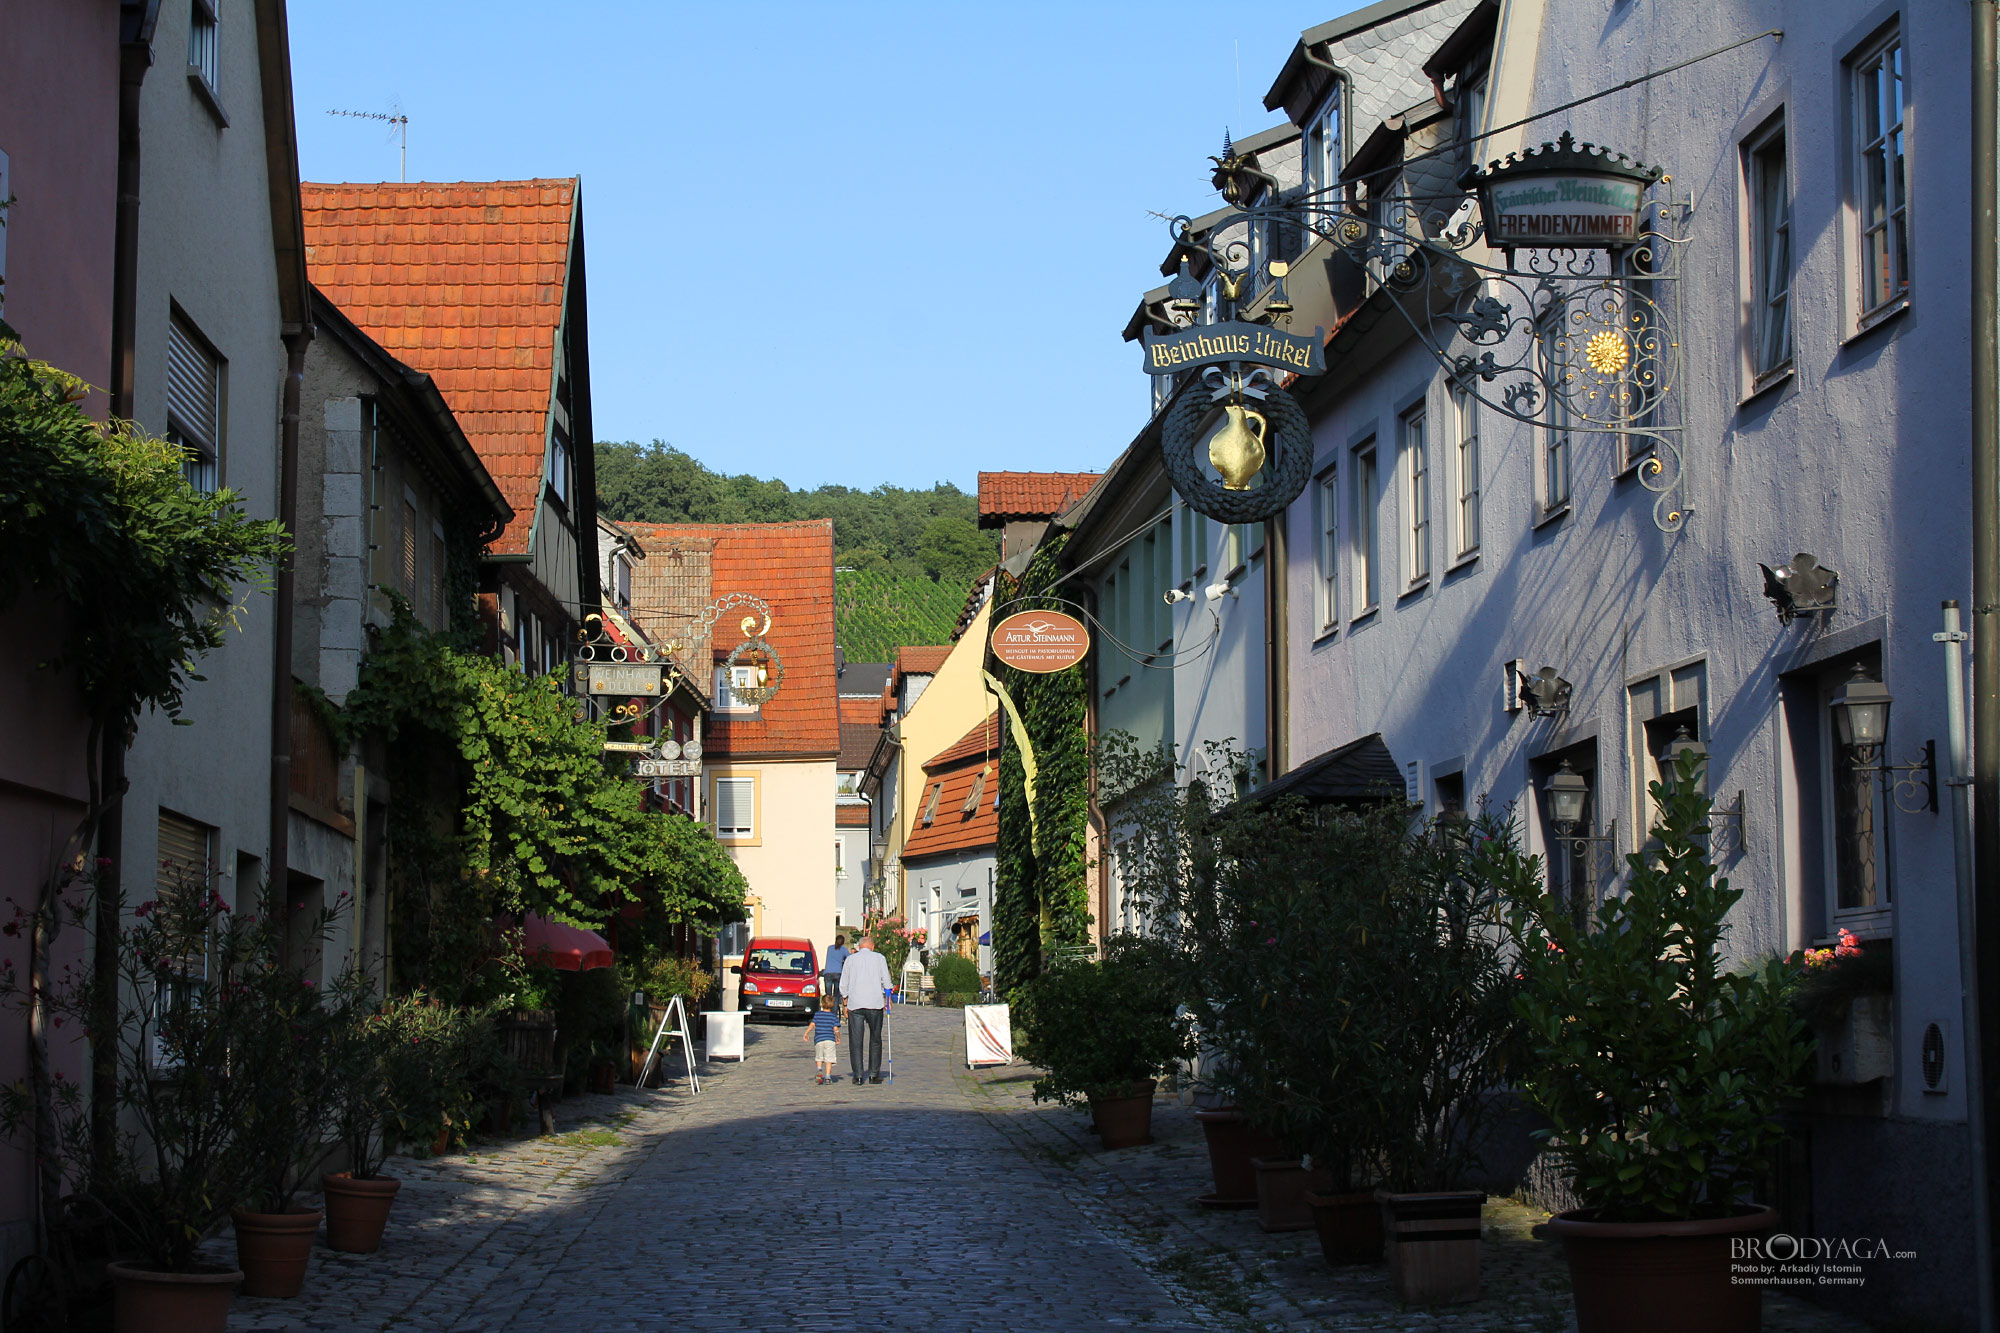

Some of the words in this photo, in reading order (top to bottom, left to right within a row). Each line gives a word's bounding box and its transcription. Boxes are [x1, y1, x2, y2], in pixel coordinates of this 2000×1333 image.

[1557, 179, 1638, 211] Weinkeller
[1498, 214, 1633, 236] FREMDENZIMMER
[1151, 334, 1250, 368] Weinhaus
[1254, 331, 1311, 369] Unkel
[1005, 631, 1031, 643] ARTUR
[1033, 631, 1075, 643] STEINMANN
[594, 669, 658, 680] WEINHAUS
[636, 761, 694, 775] OTEL
